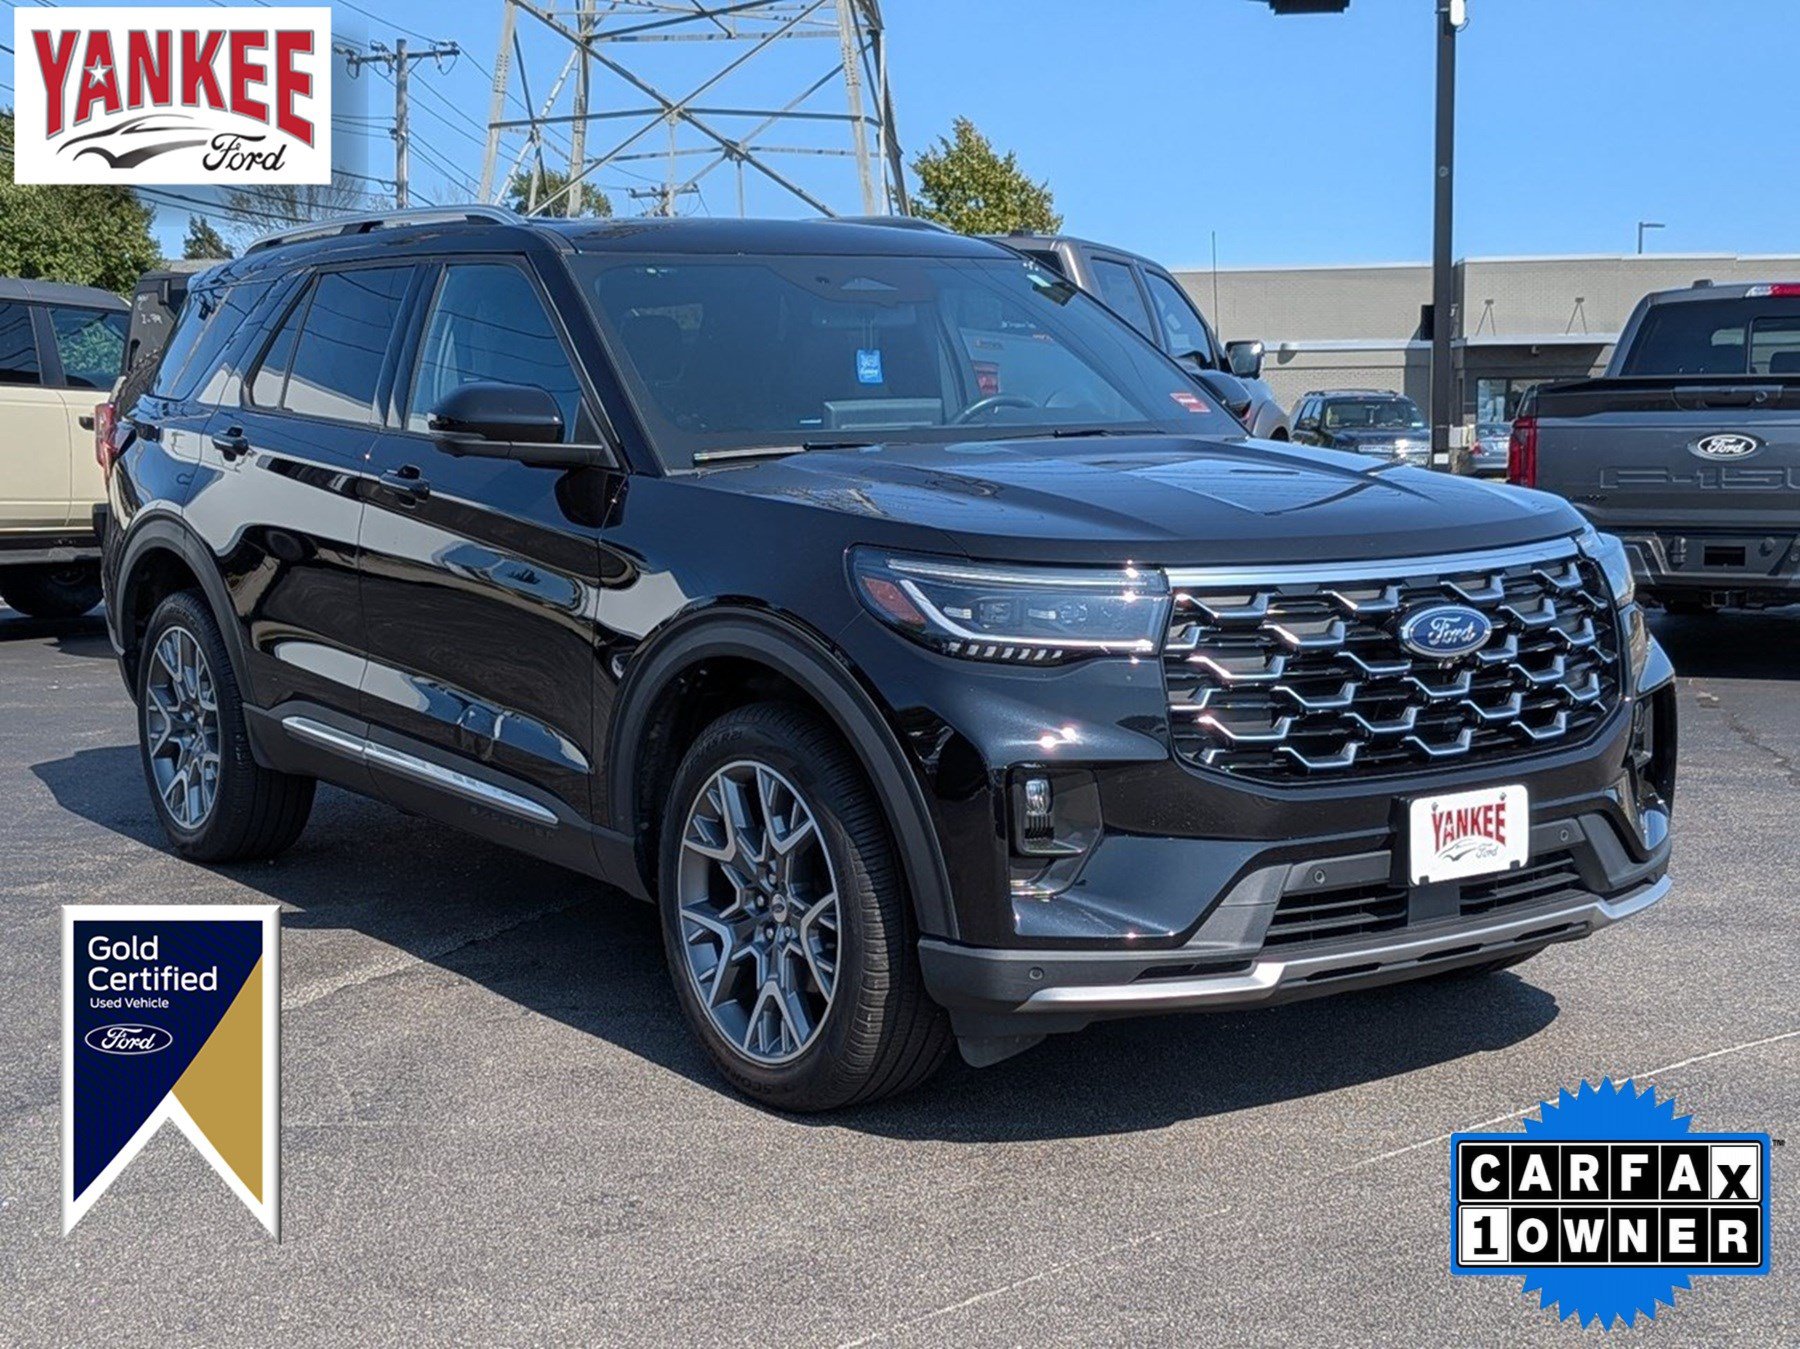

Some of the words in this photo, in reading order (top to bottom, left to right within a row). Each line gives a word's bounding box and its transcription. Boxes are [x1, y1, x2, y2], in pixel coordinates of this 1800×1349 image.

[1706, 438, 1746, 454] Ford
[1600, 466, 1800, 490] F-15
[1428, 616, 1476, 646] Ford
[1431, 802, 1506, 854] YANKEE
